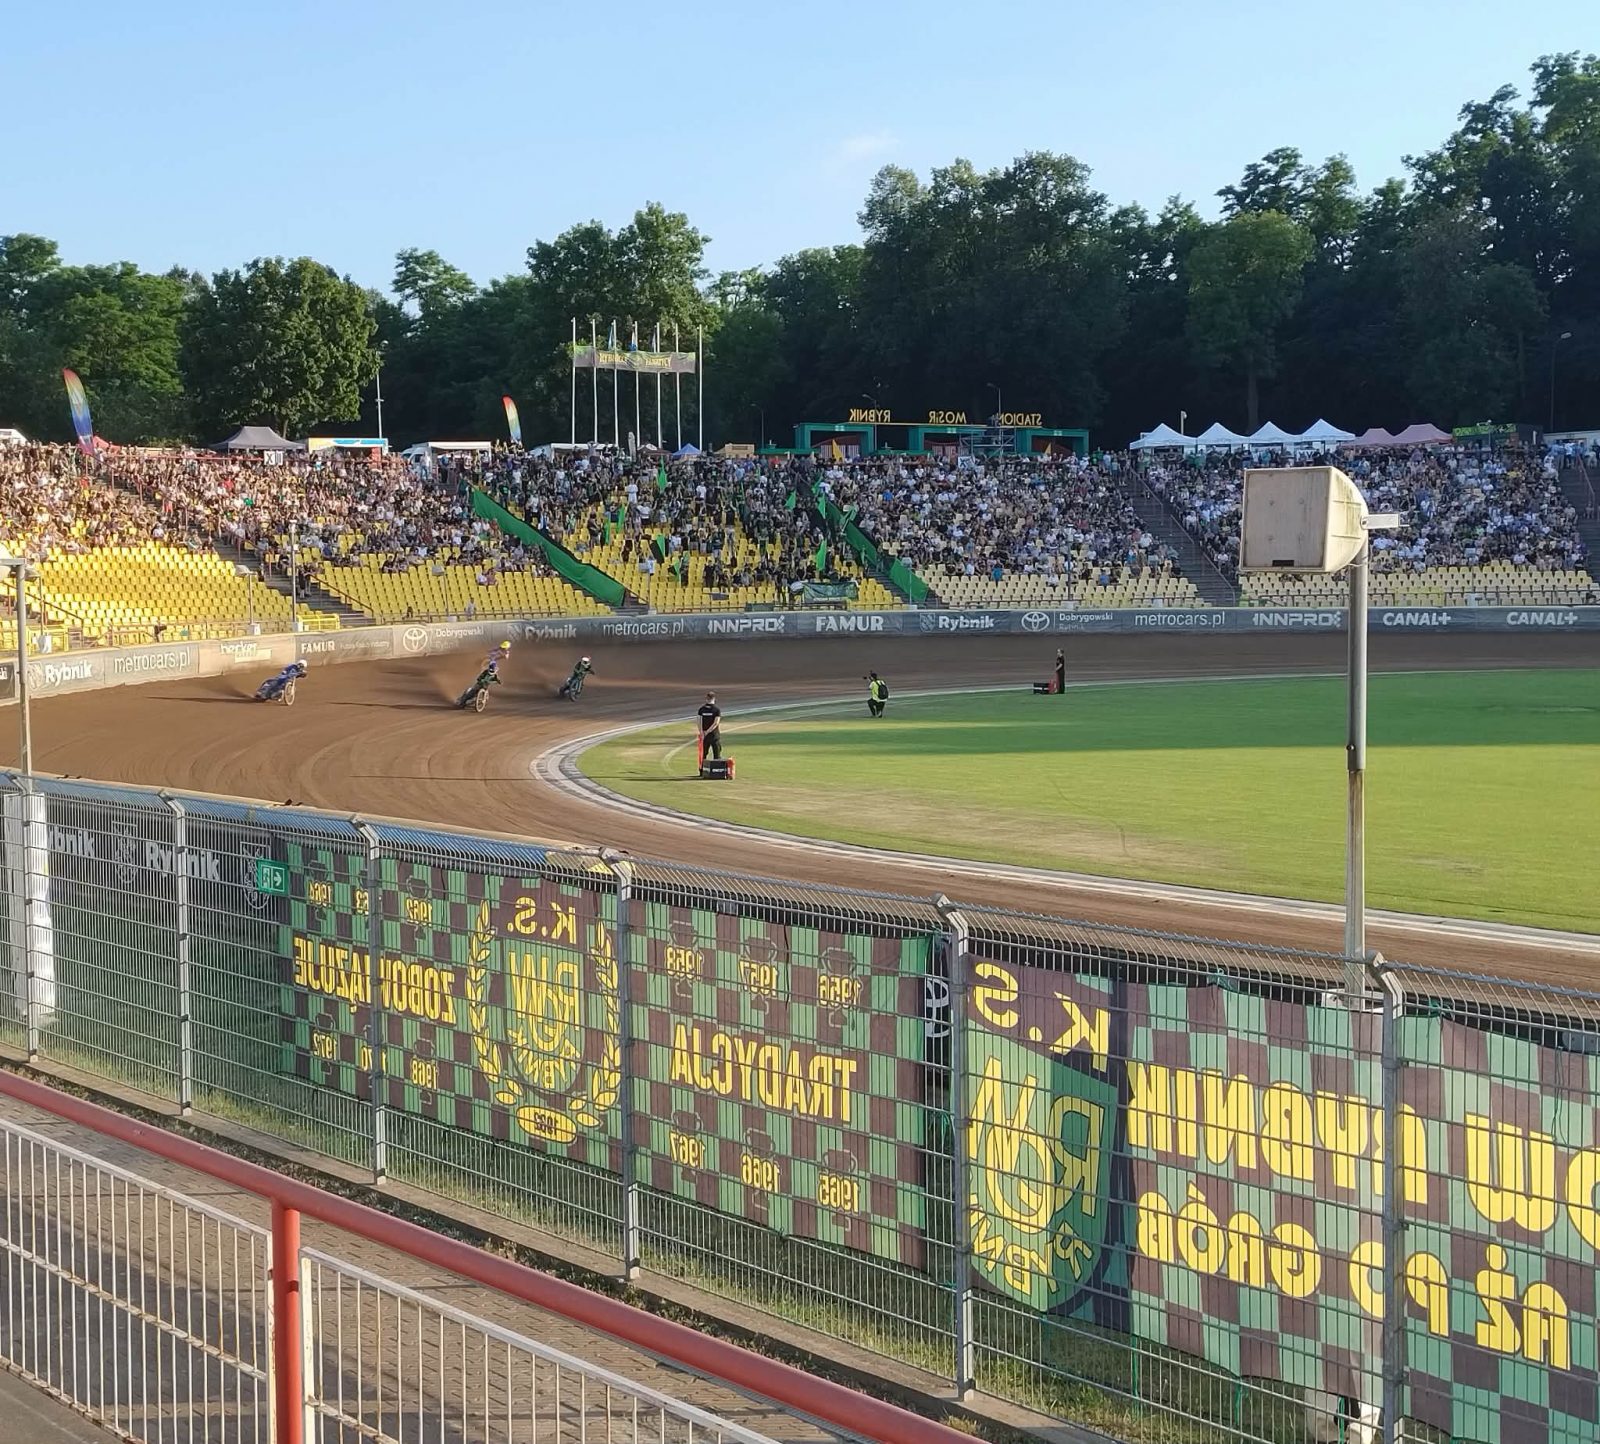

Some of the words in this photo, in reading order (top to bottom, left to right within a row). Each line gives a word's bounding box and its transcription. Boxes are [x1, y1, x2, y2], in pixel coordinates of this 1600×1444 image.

[707, 617, 779, 634] INNPRO
[815, 615, 884, 633] FAMUR
[938, 614, 995, 631] Rybnik
[1059, 612, 1113, 623] Dobrygowski
[1134, 611, 1226, 628] metrocars.pl
[1252, 612, 1333, 627] INNPRO
[1382, 612, 1451, 627] CANAL+
[1506, 611, 1578, 626] CANAL+
[435, 626, 484, 639] Dobrygowski
[525, 624, 577, 642] Rybnik
[603, 618, 685, 637] metrocars.pl
[300, 640, 336, 654] FAMUR
[113, 648, 191, 674] metrocars.pl
[45, 659, 92, 687] Rybnik
[47, 826, 95, 858] bnik
[146, 841, 219, 881] Rynik
